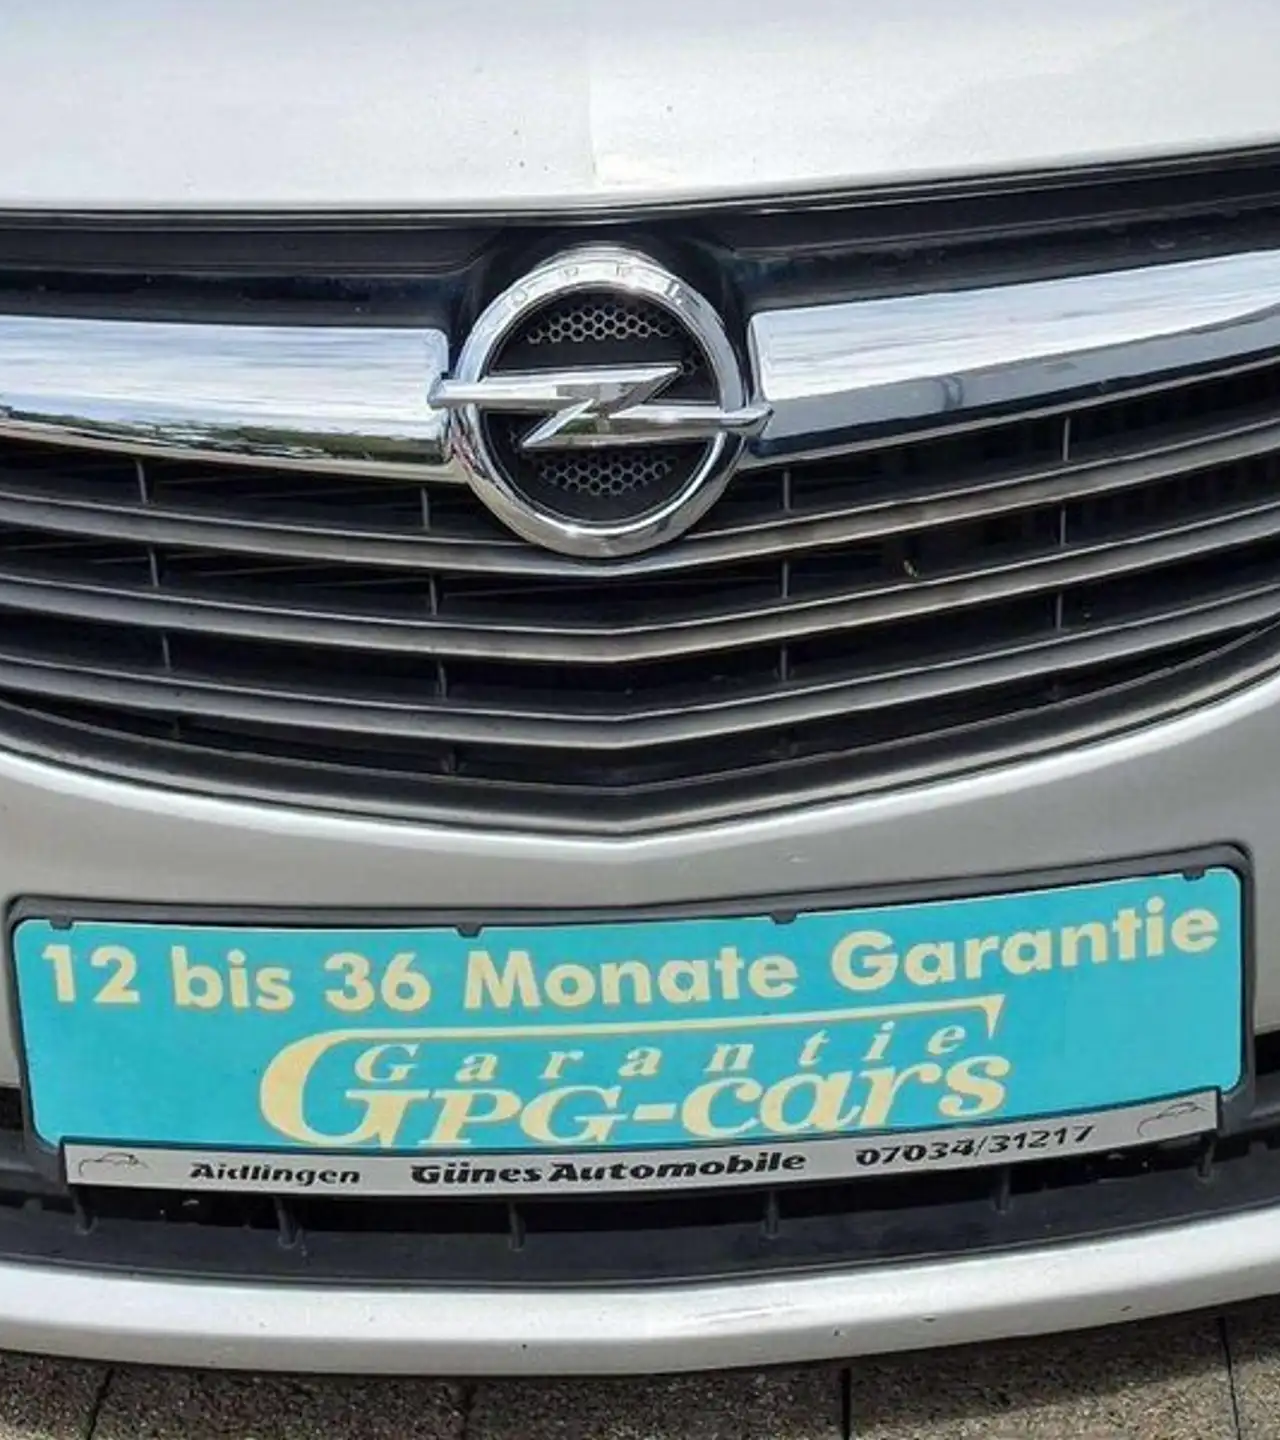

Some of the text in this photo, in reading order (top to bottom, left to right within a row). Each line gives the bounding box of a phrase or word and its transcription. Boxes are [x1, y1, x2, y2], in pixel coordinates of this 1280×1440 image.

[41, 897, 1219, 1013] 12 bis 36 Monate Garantie
[258, 1027, 1012, 1148] GPG-cars
[353, 1022, 966, 1083] Garantie
[190, 1124, 1095, 1186] Aidlingen Günes Automobile 07034/31217
